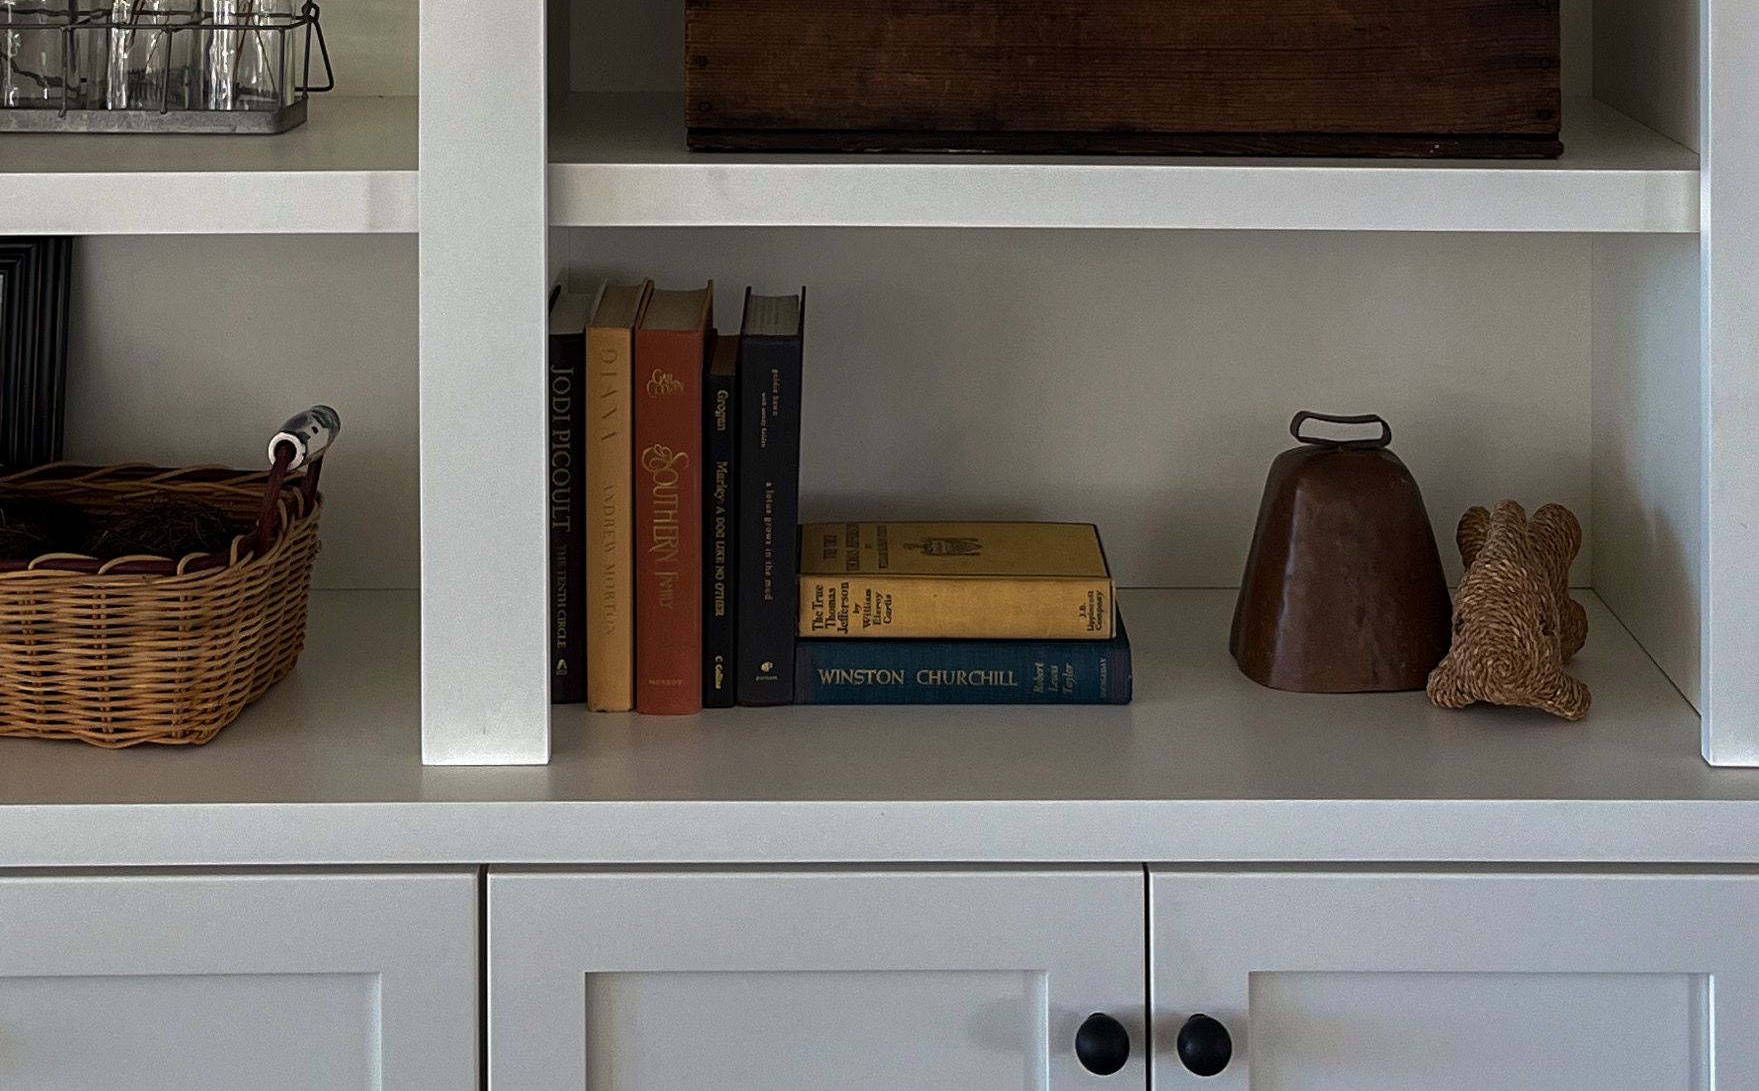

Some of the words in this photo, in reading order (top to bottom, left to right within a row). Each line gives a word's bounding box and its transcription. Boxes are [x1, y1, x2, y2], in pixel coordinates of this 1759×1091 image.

[551, 365, 574, 421] JODI
[714, 389, 729, 431] Grogan
[552, 429, 571, 532] PICOULT
[603, 484, 616, 554] ANDREW
[641, 444, 690, 563] SOUTHERN
[716, 517, 726, 538] DOG
[763, 517, 773, 545] grows
[716, 541, 726, 563] LIKE
[766, 548, 774, 558] in
[716, 565, 726, 580] NO
[766, 561, 774, 576] the
[557, 569, 568, 607] TENTH
[603, 564, 616, 637] MORTON
[715, 582, 726, 617] OTHER
[812, 584, 823, 610] True
[812, 610, 823, 631] The
[825, 588, 836, 629] Thomas
[837, 582, 849, 634] Jefferson
[852, 603, 862, 614] by
[863, 589, 872, 629] William
[883, 594, 892, 624] Curtis
[557, 610, 568, 649] CIRCLE
[817, 669, 905, 685] WINSTON
[916, 669, 1018, 686] CHURCHILL
[1033, 662, 1044, 693] Robert
[1062, 662, 1077, 694] Taylor
